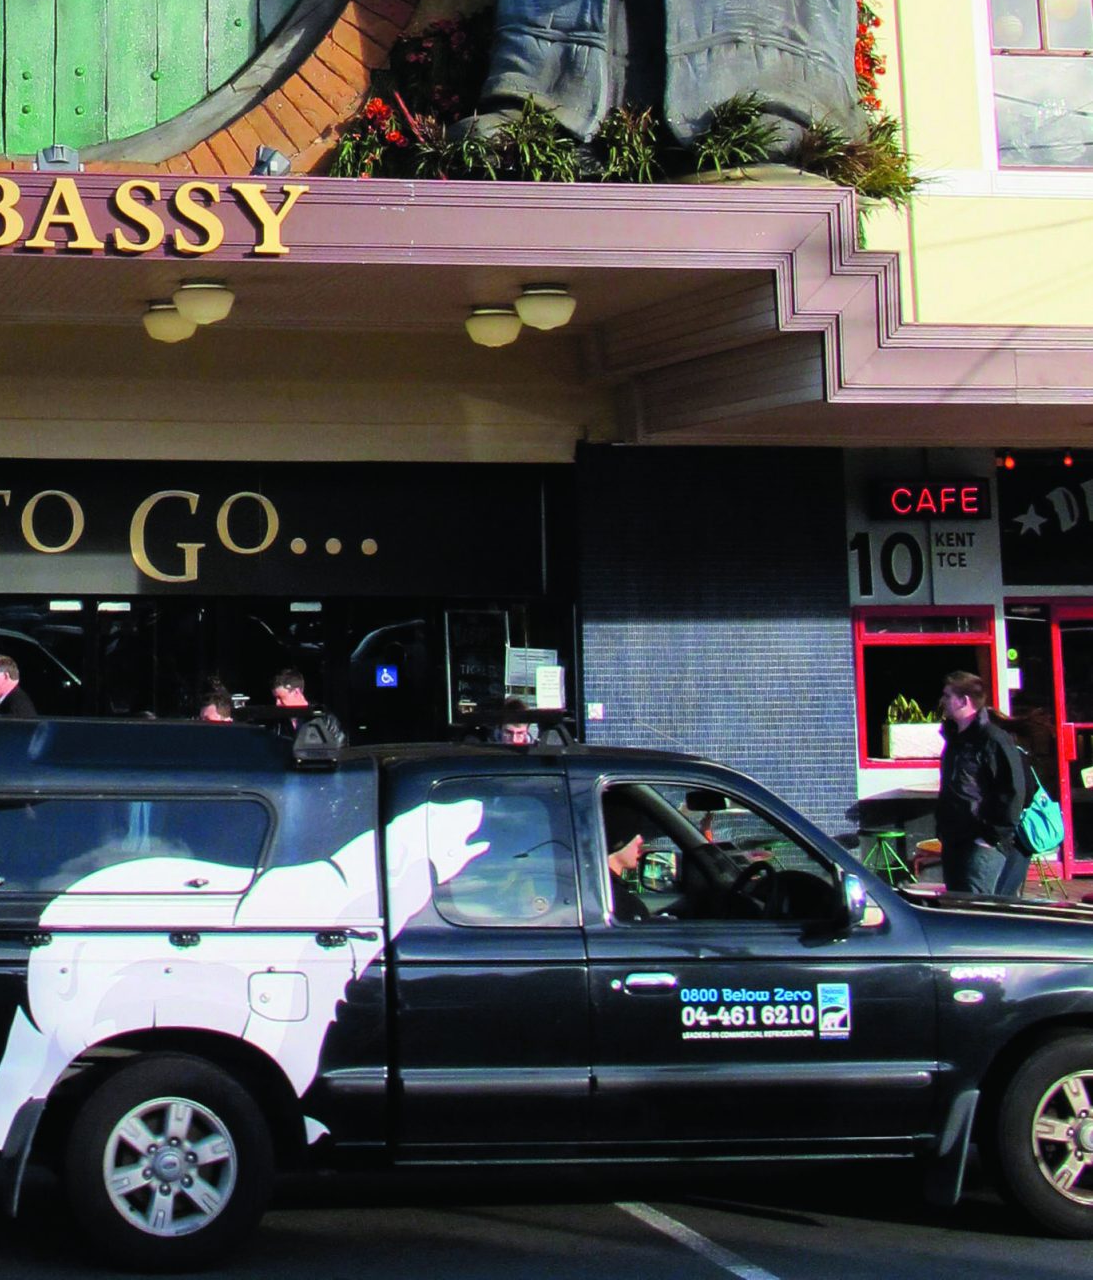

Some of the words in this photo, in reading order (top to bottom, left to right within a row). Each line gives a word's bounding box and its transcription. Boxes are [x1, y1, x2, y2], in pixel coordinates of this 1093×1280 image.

[890, 487, 979, 513] CAFE
[934, 532, 976, 549] KENT
[849, 531, 924, 597] 10
[936, 552, 968, 568] TCE
[679, 988, 719, 1003] 0800
[721, 988, 770, 1002] Below
[773, 987, 813, 1002] Zero
[680, 1005, 757, 1027] 04-461
[760, 1004, 816, 1025] 6210
